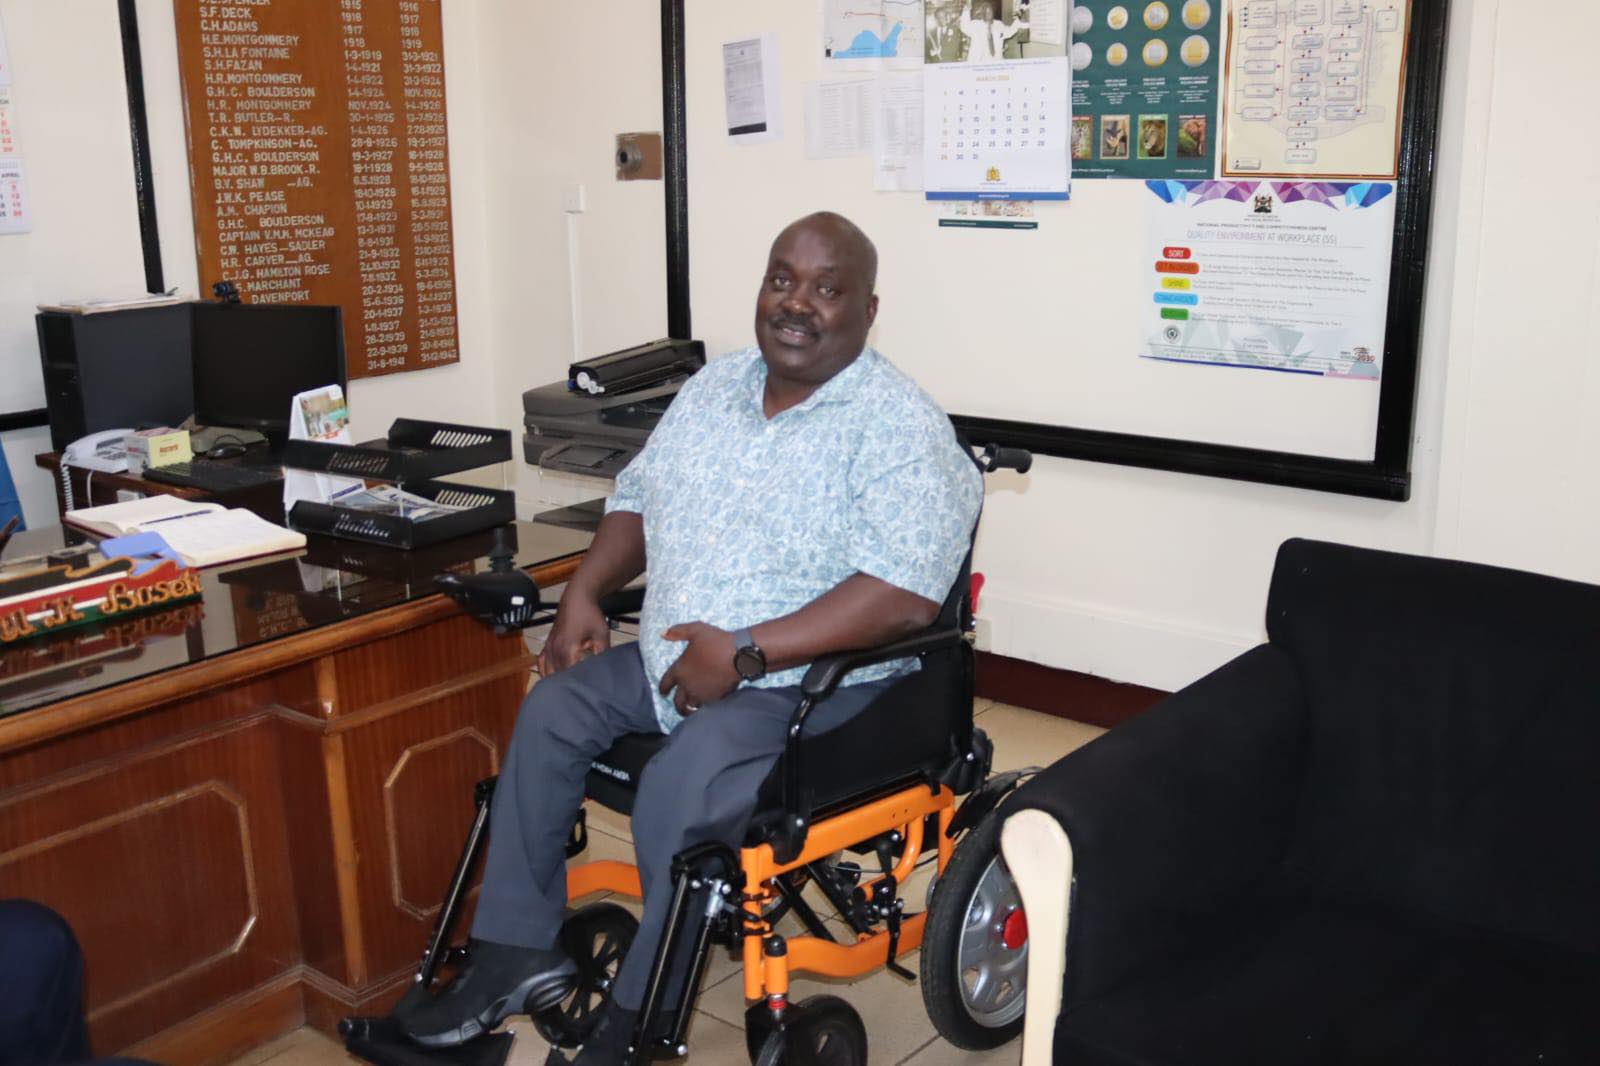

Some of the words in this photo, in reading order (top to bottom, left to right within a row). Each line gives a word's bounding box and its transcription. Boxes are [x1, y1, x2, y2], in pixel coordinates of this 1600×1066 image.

[247, 86, 315, 97] BOULDERSON
[254, 151, 319, 162] BOULDERSON
[212, 165, 247, 177] MAJOR
[236, 177, 265, 189] SHAW
[249, 190, 286, 202] PEASE
[259, 215, 325, 228] BOULDERSON
[219, 230, 261, 243] CAPTAIN
[1187, 229, 1215, 240] QUALITY
[1216, 231, 1266, 242] ENVIRONMENT
[1267, 233, 1276, 242] AT
[1277, 233, 1321, 244] WORKPLACE
[1168, 248, 1184, 257] SORT
[256, 266, 301, 279] HAMILTON
[304, 264, 331, 276] ROSE
[251, 290, 310, 305] DAVENPORT
